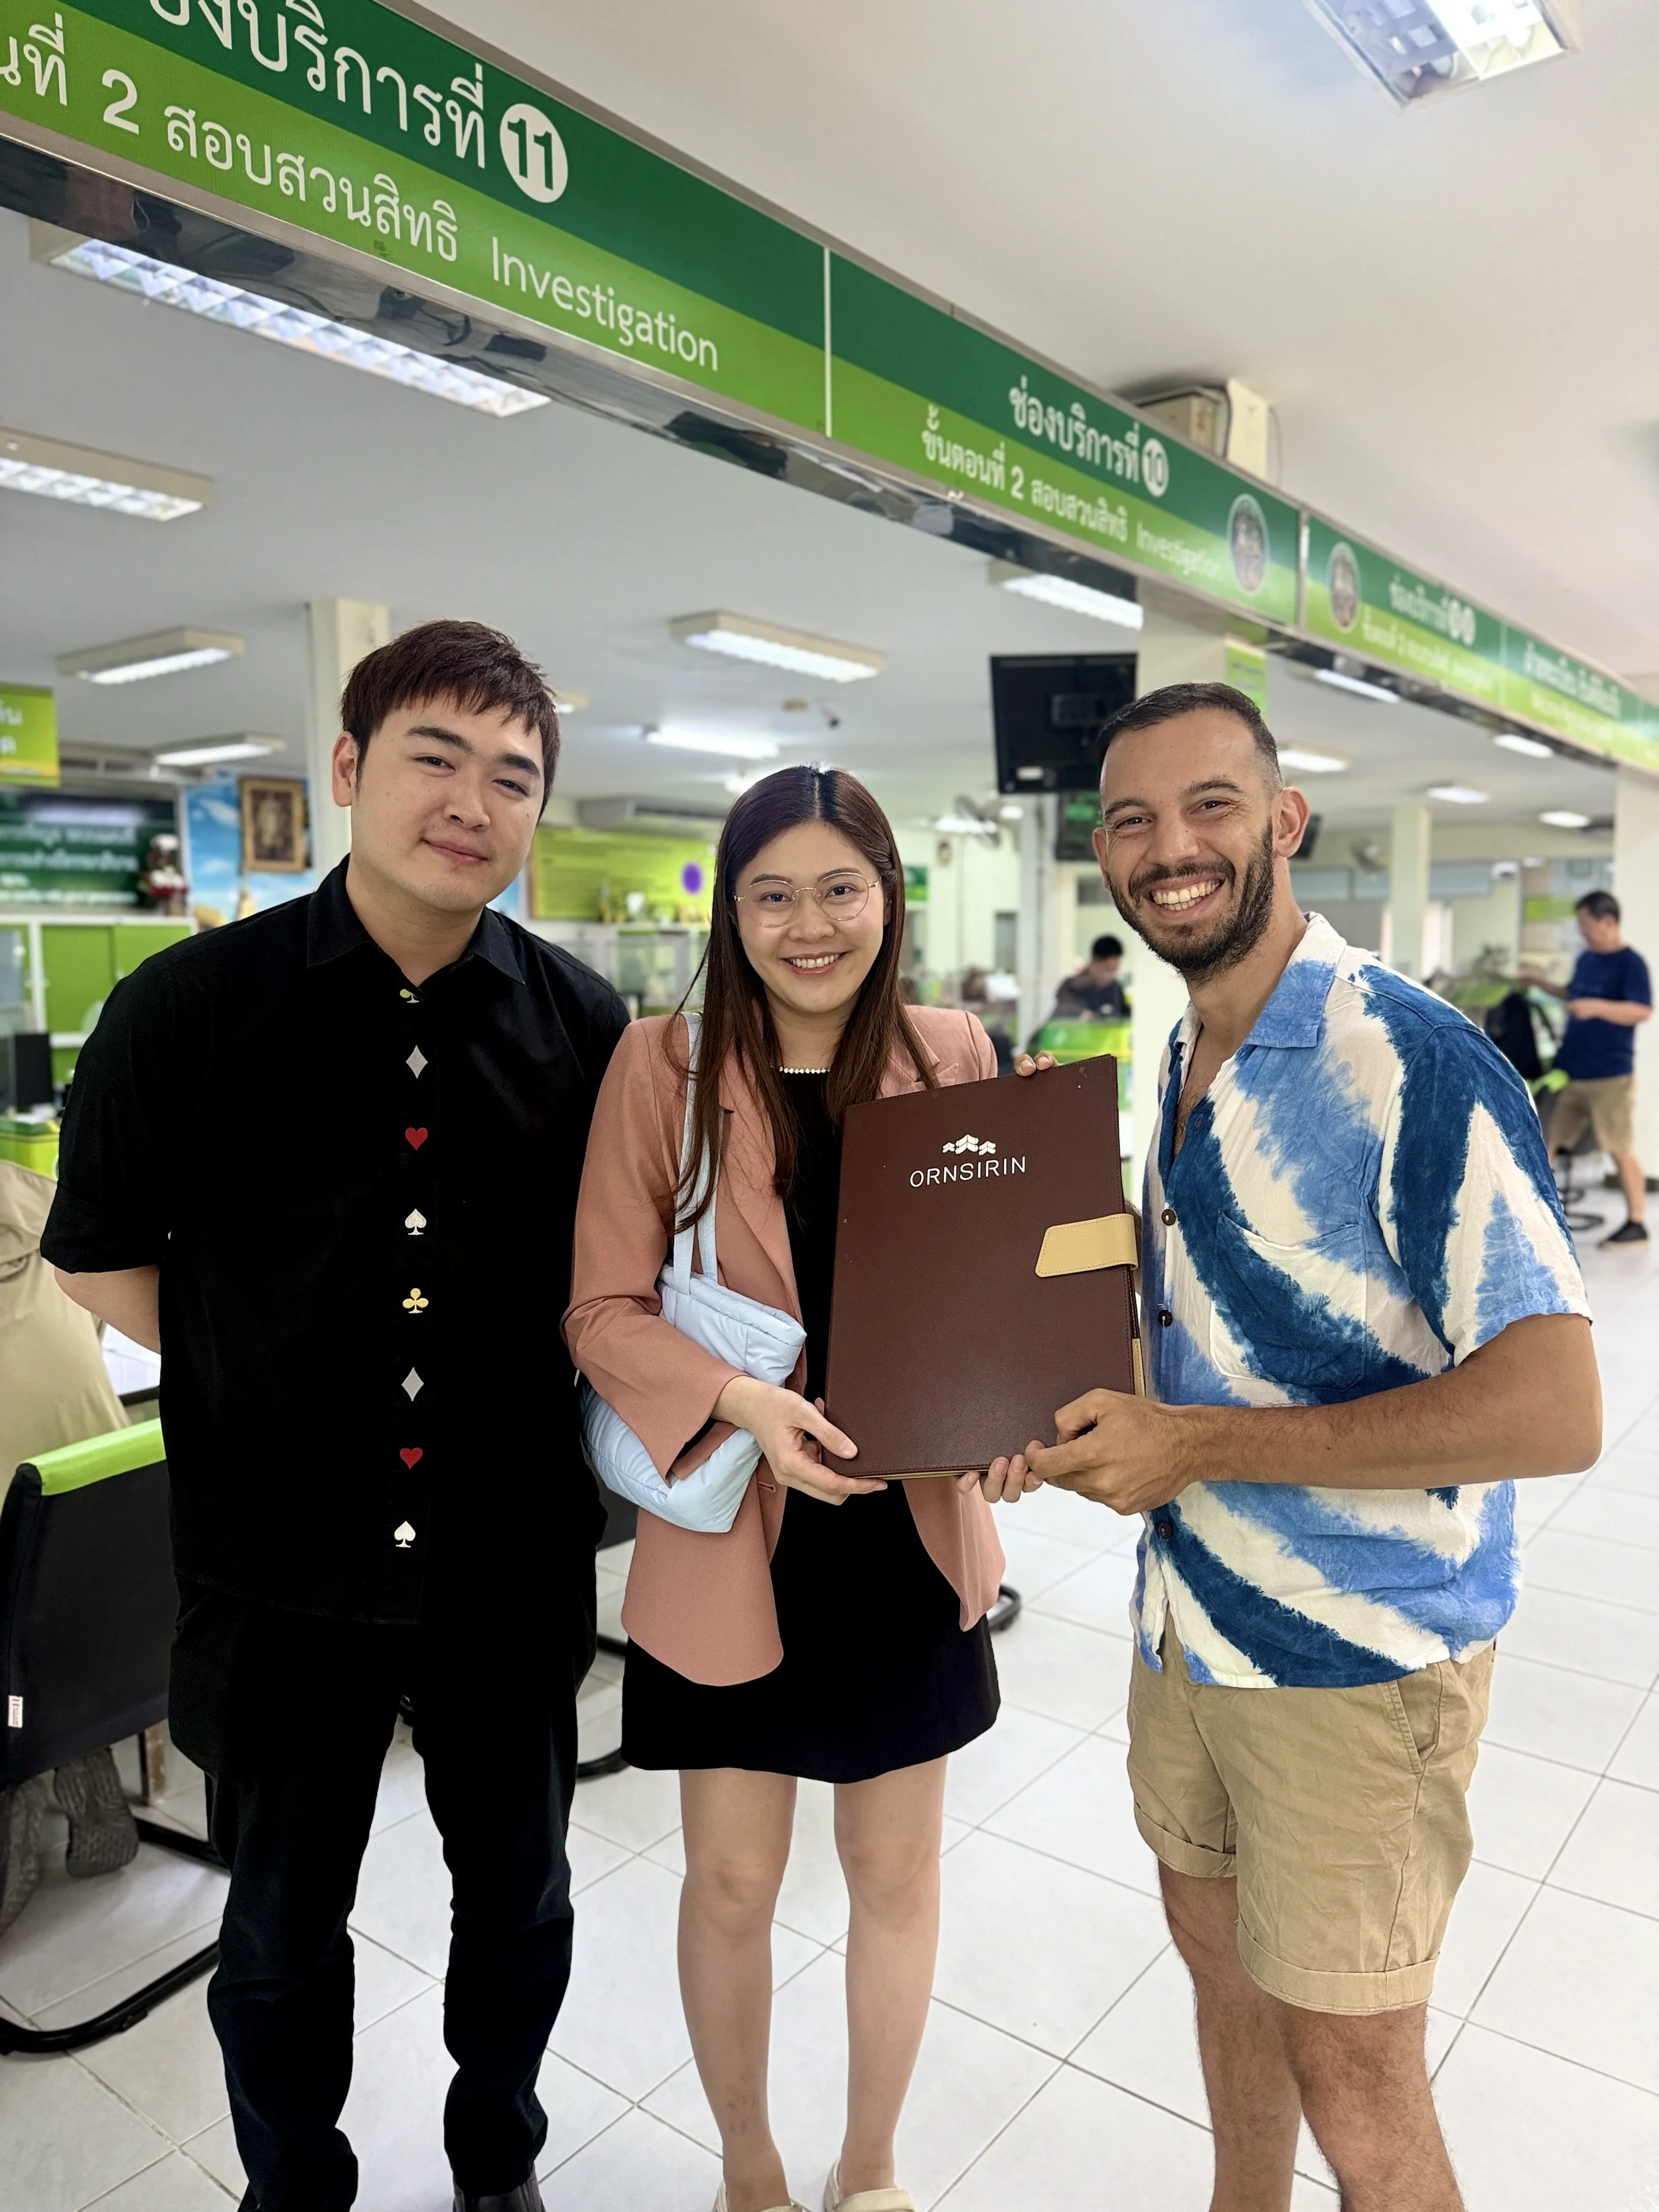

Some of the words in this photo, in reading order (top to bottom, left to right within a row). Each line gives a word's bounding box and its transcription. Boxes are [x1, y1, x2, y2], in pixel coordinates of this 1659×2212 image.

[506, 117, 554, 192] 11
[102, 68, 139, 135] 2
[164, 105, 458, 262] สอบสวนสิทธิ
[491, 236, 719, 372] Investigation
[1009, 374, 1139, 484] ช่องบริการที่
[1010, 465, 1025, 500] 2
[909, 1155, 1026, 1187] ORNSIRIN
